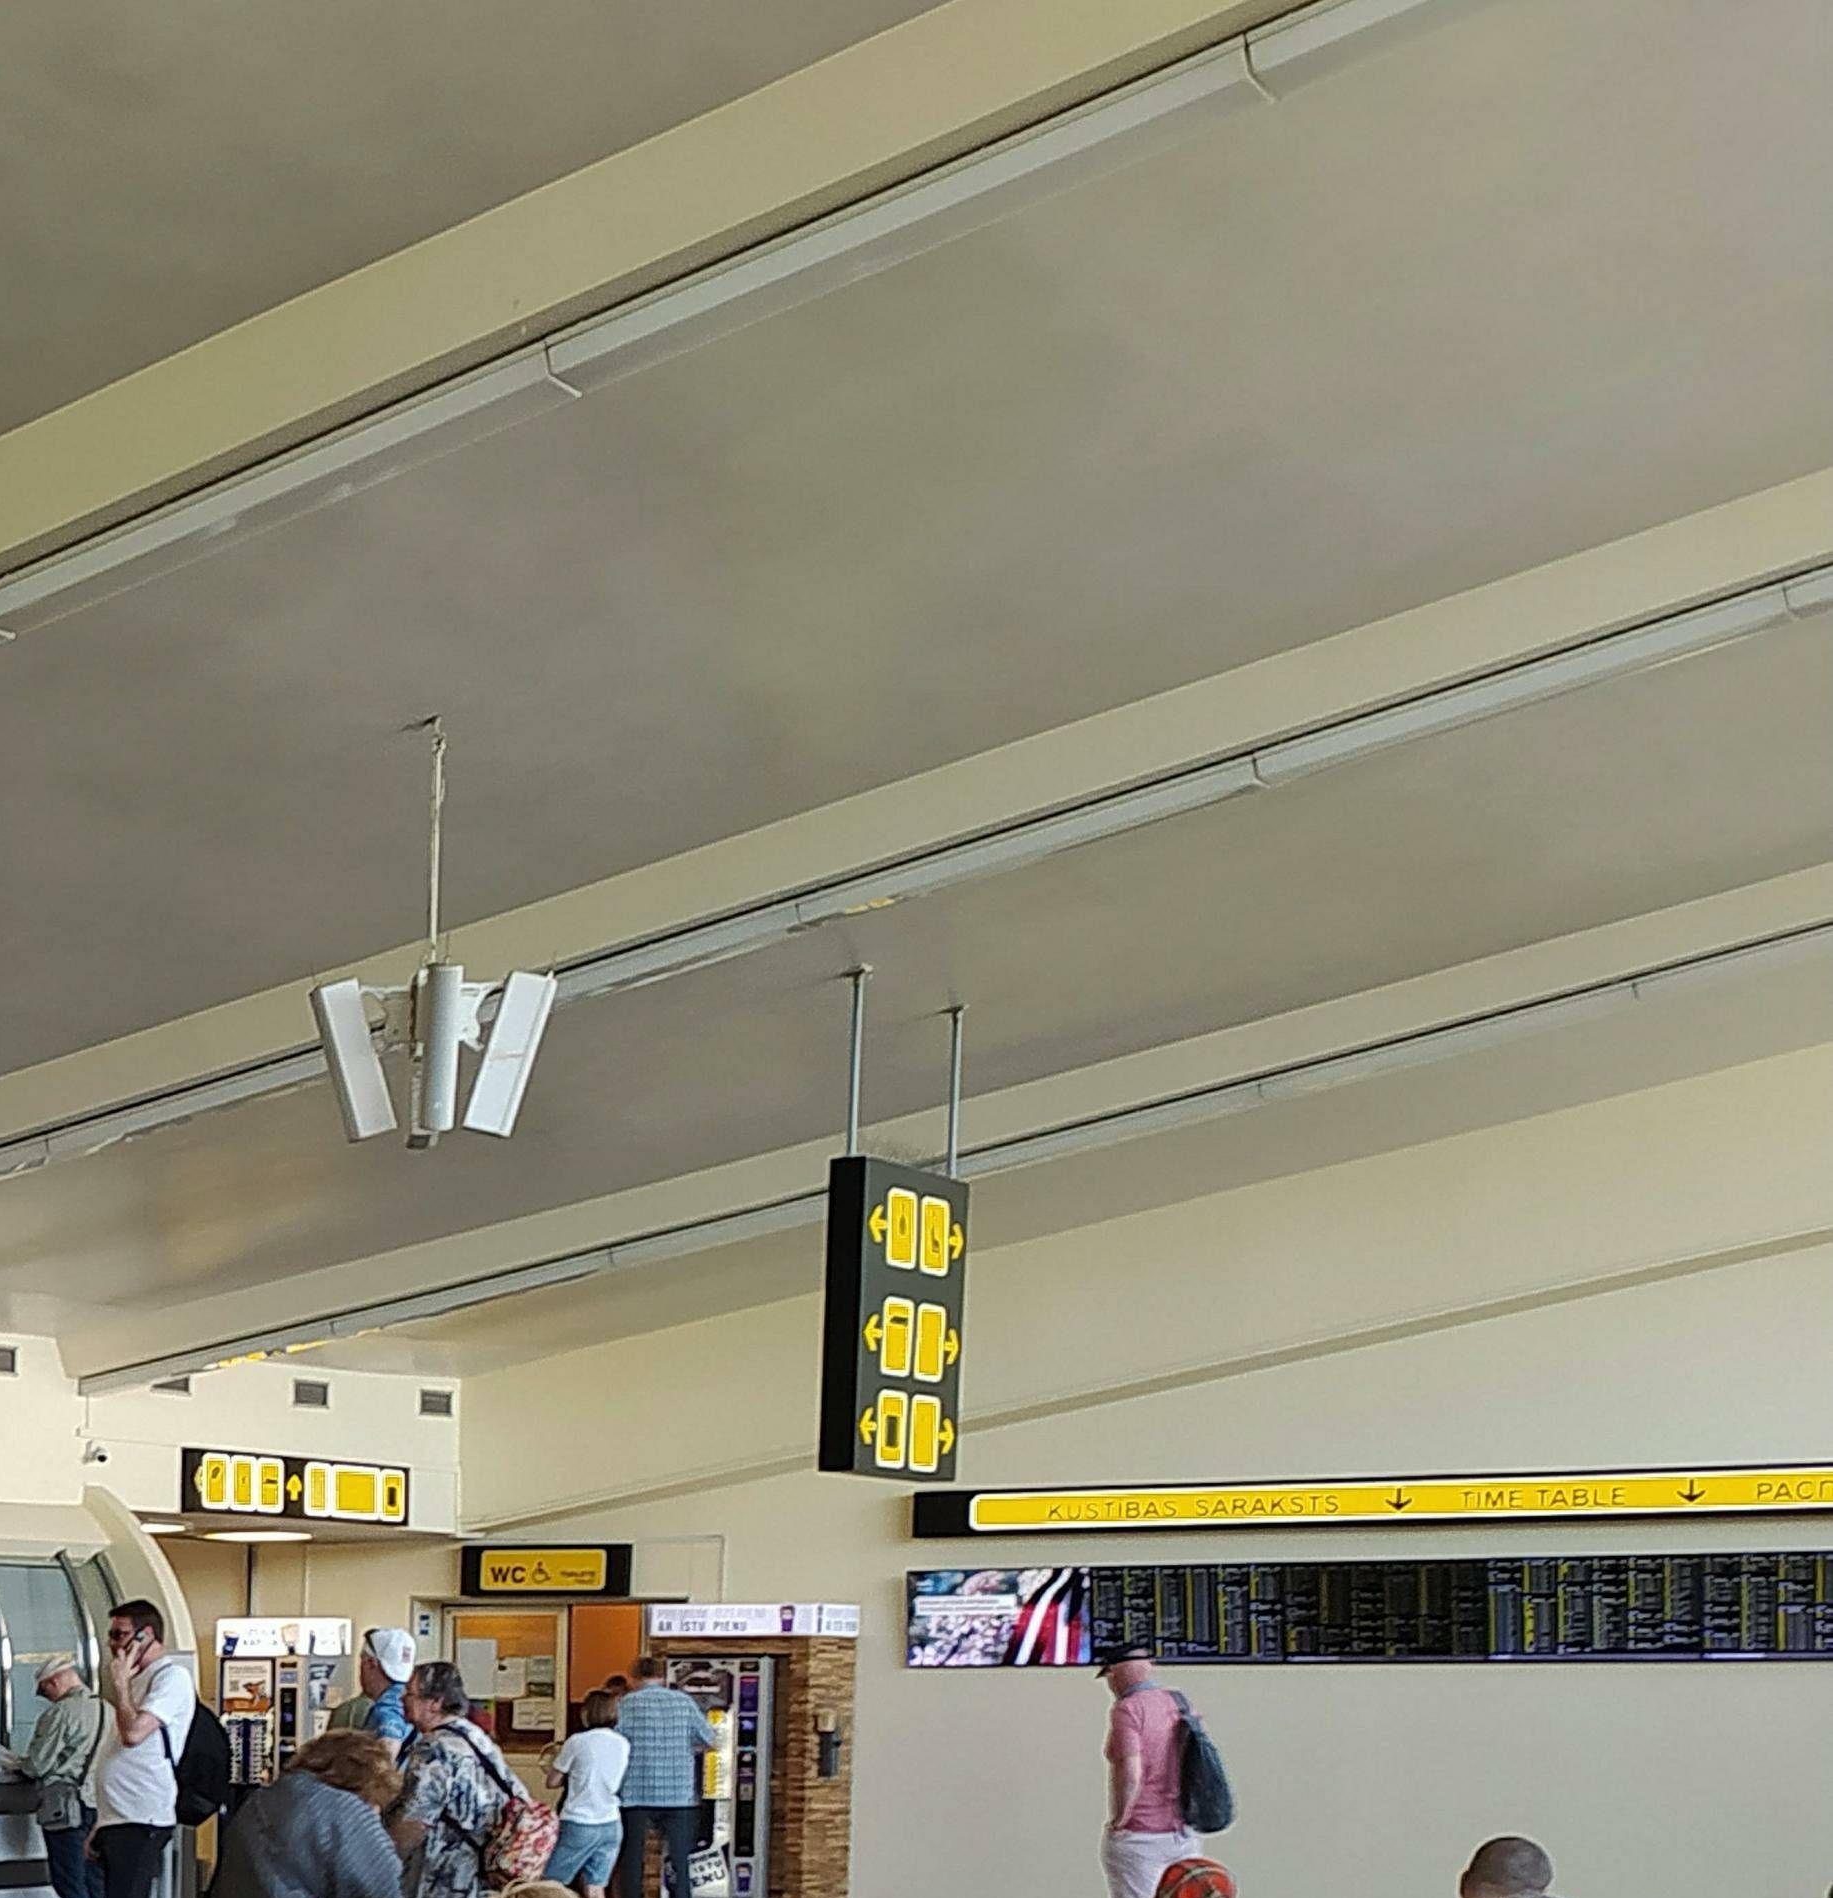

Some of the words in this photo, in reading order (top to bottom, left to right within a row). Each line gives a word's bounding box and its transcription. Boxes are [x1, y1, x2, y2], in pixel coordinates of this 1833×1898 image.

[1195, 1494, 1339, 1517] SARAKSTS
[1462, 1488, 1524, 1508] TIME
[1535, 1486, 1626, 1507] TABLE
[489, 1565, 527, 1584] WC
